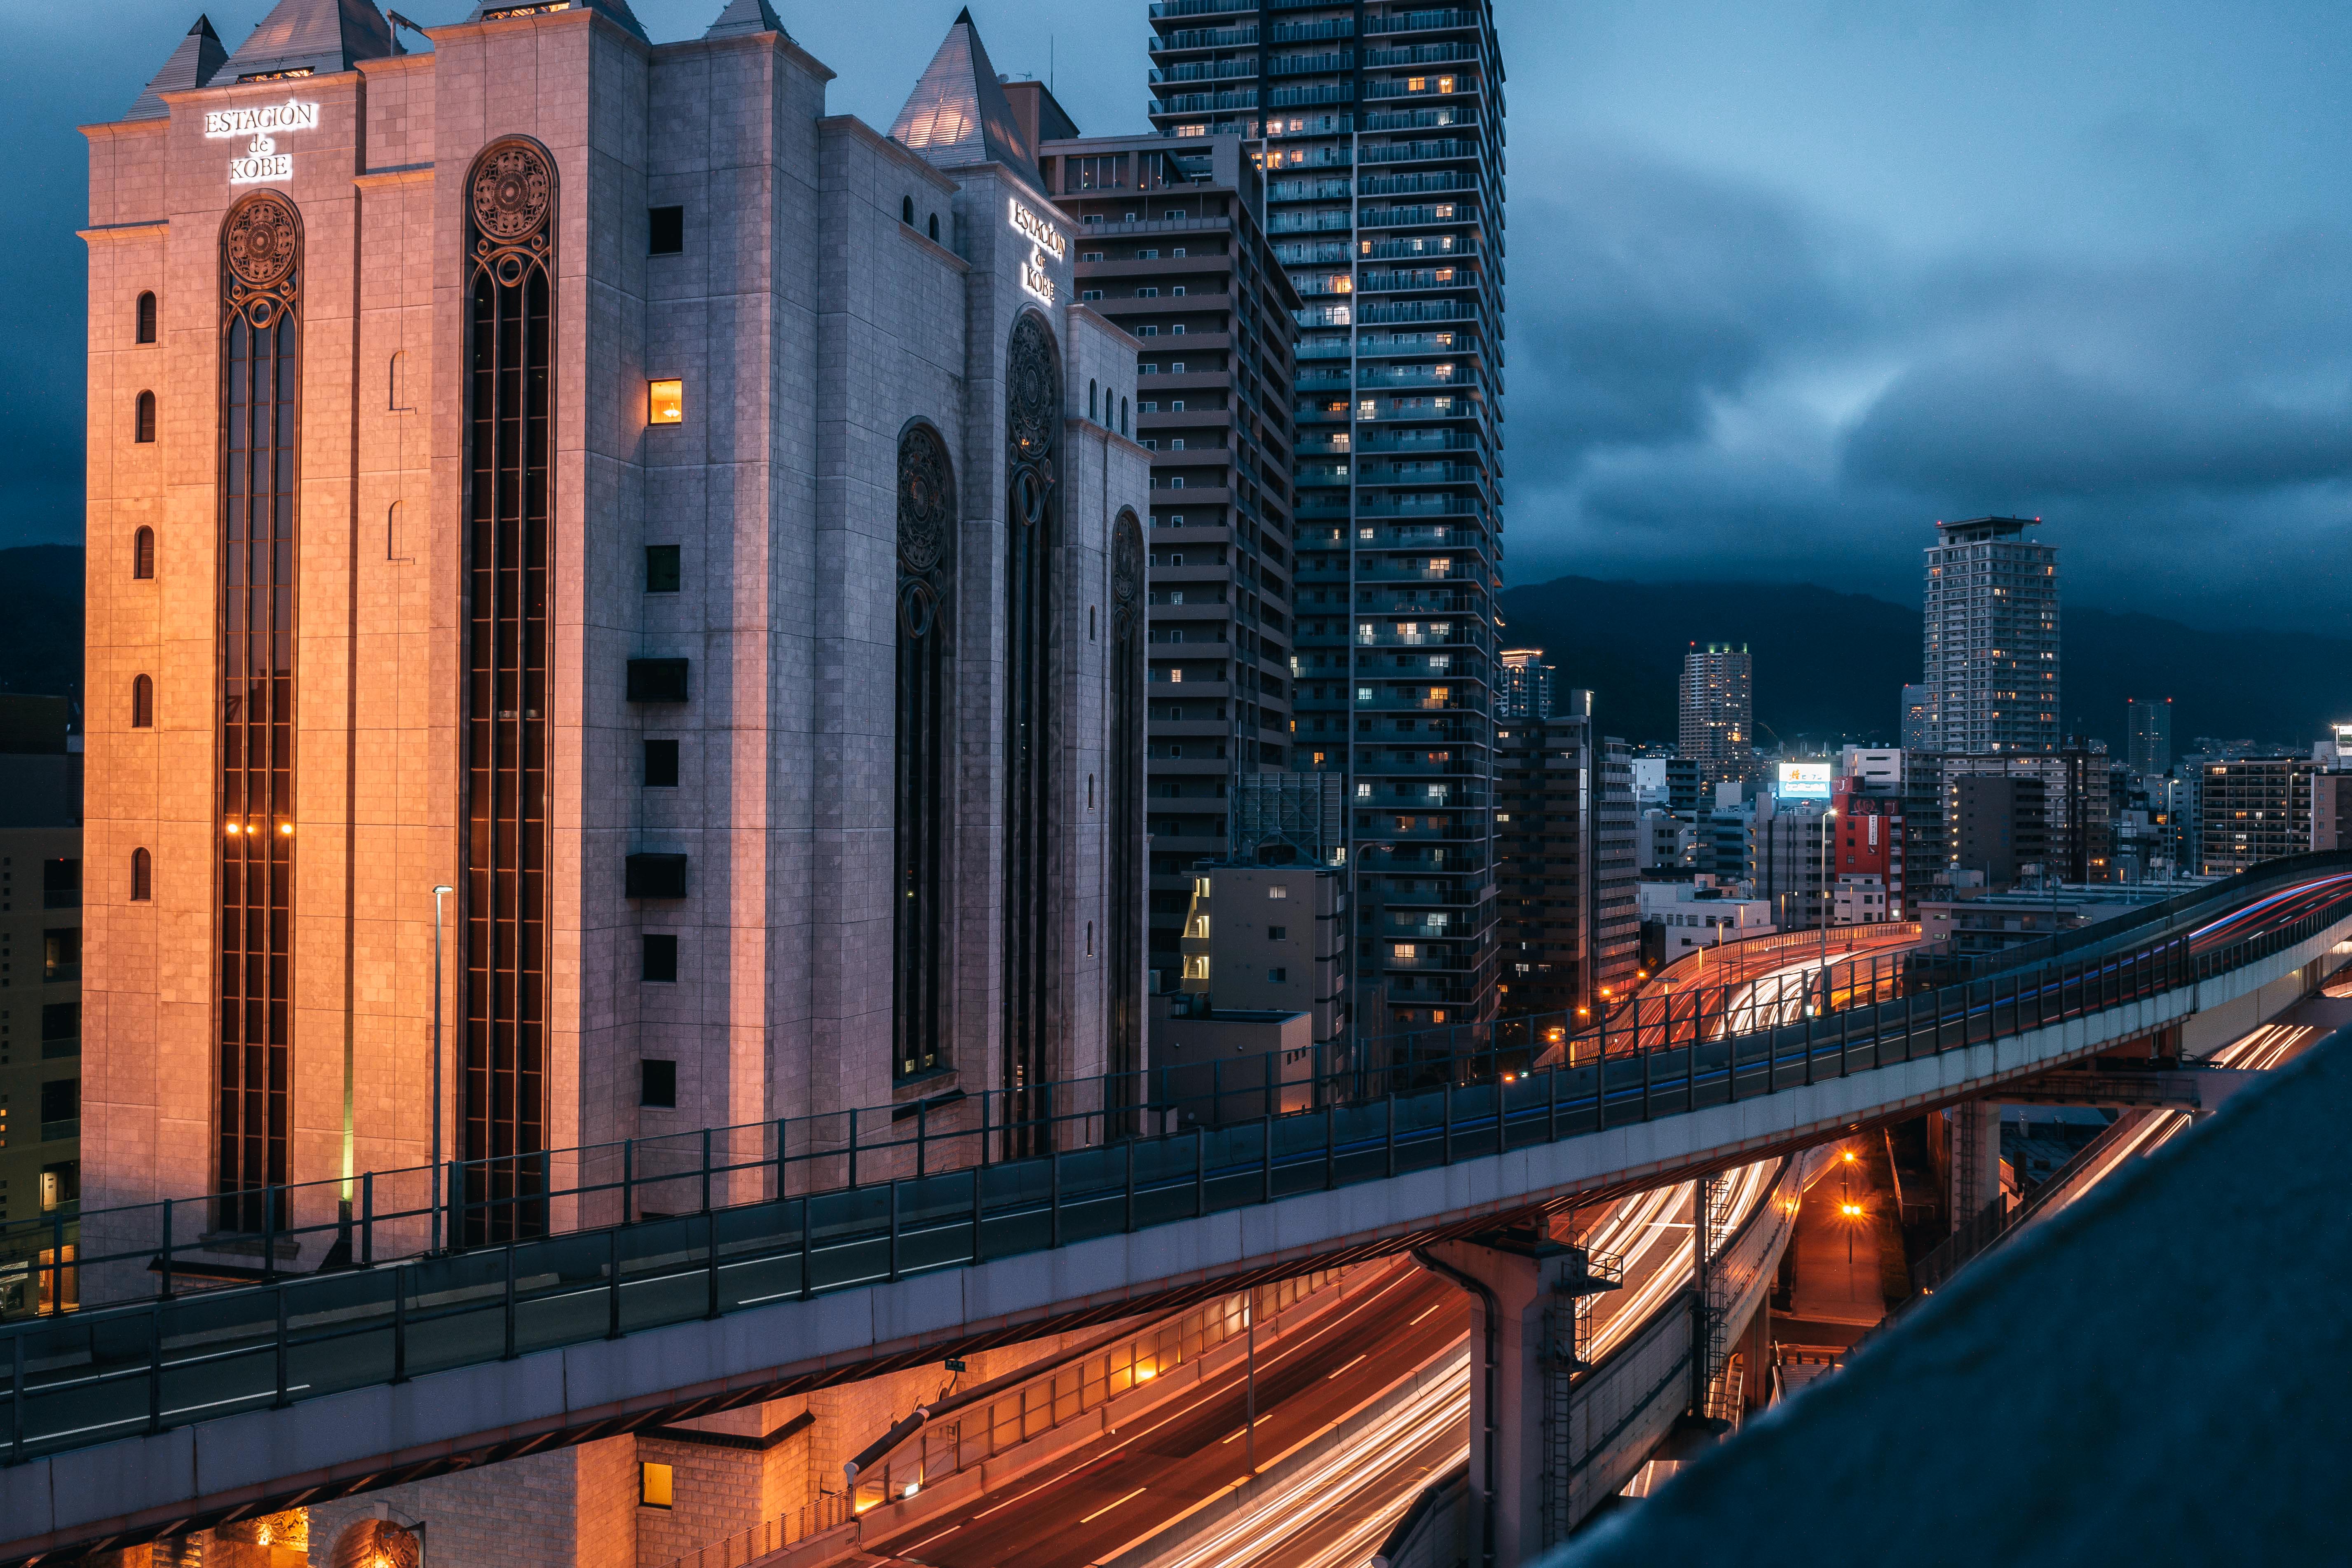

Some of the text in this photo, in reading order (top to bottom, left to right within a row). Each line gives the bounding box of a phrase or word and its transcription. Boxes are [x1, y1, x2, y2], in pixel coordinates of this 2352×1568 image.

[205, 101, 312, 133] ESTACIÓN
[249, 133, 268, 153] de
[230, 156, 287, 179] KOBE
[1035, 245, 1046, 270] de
[1026, 265, 1055, 302] KOBE
